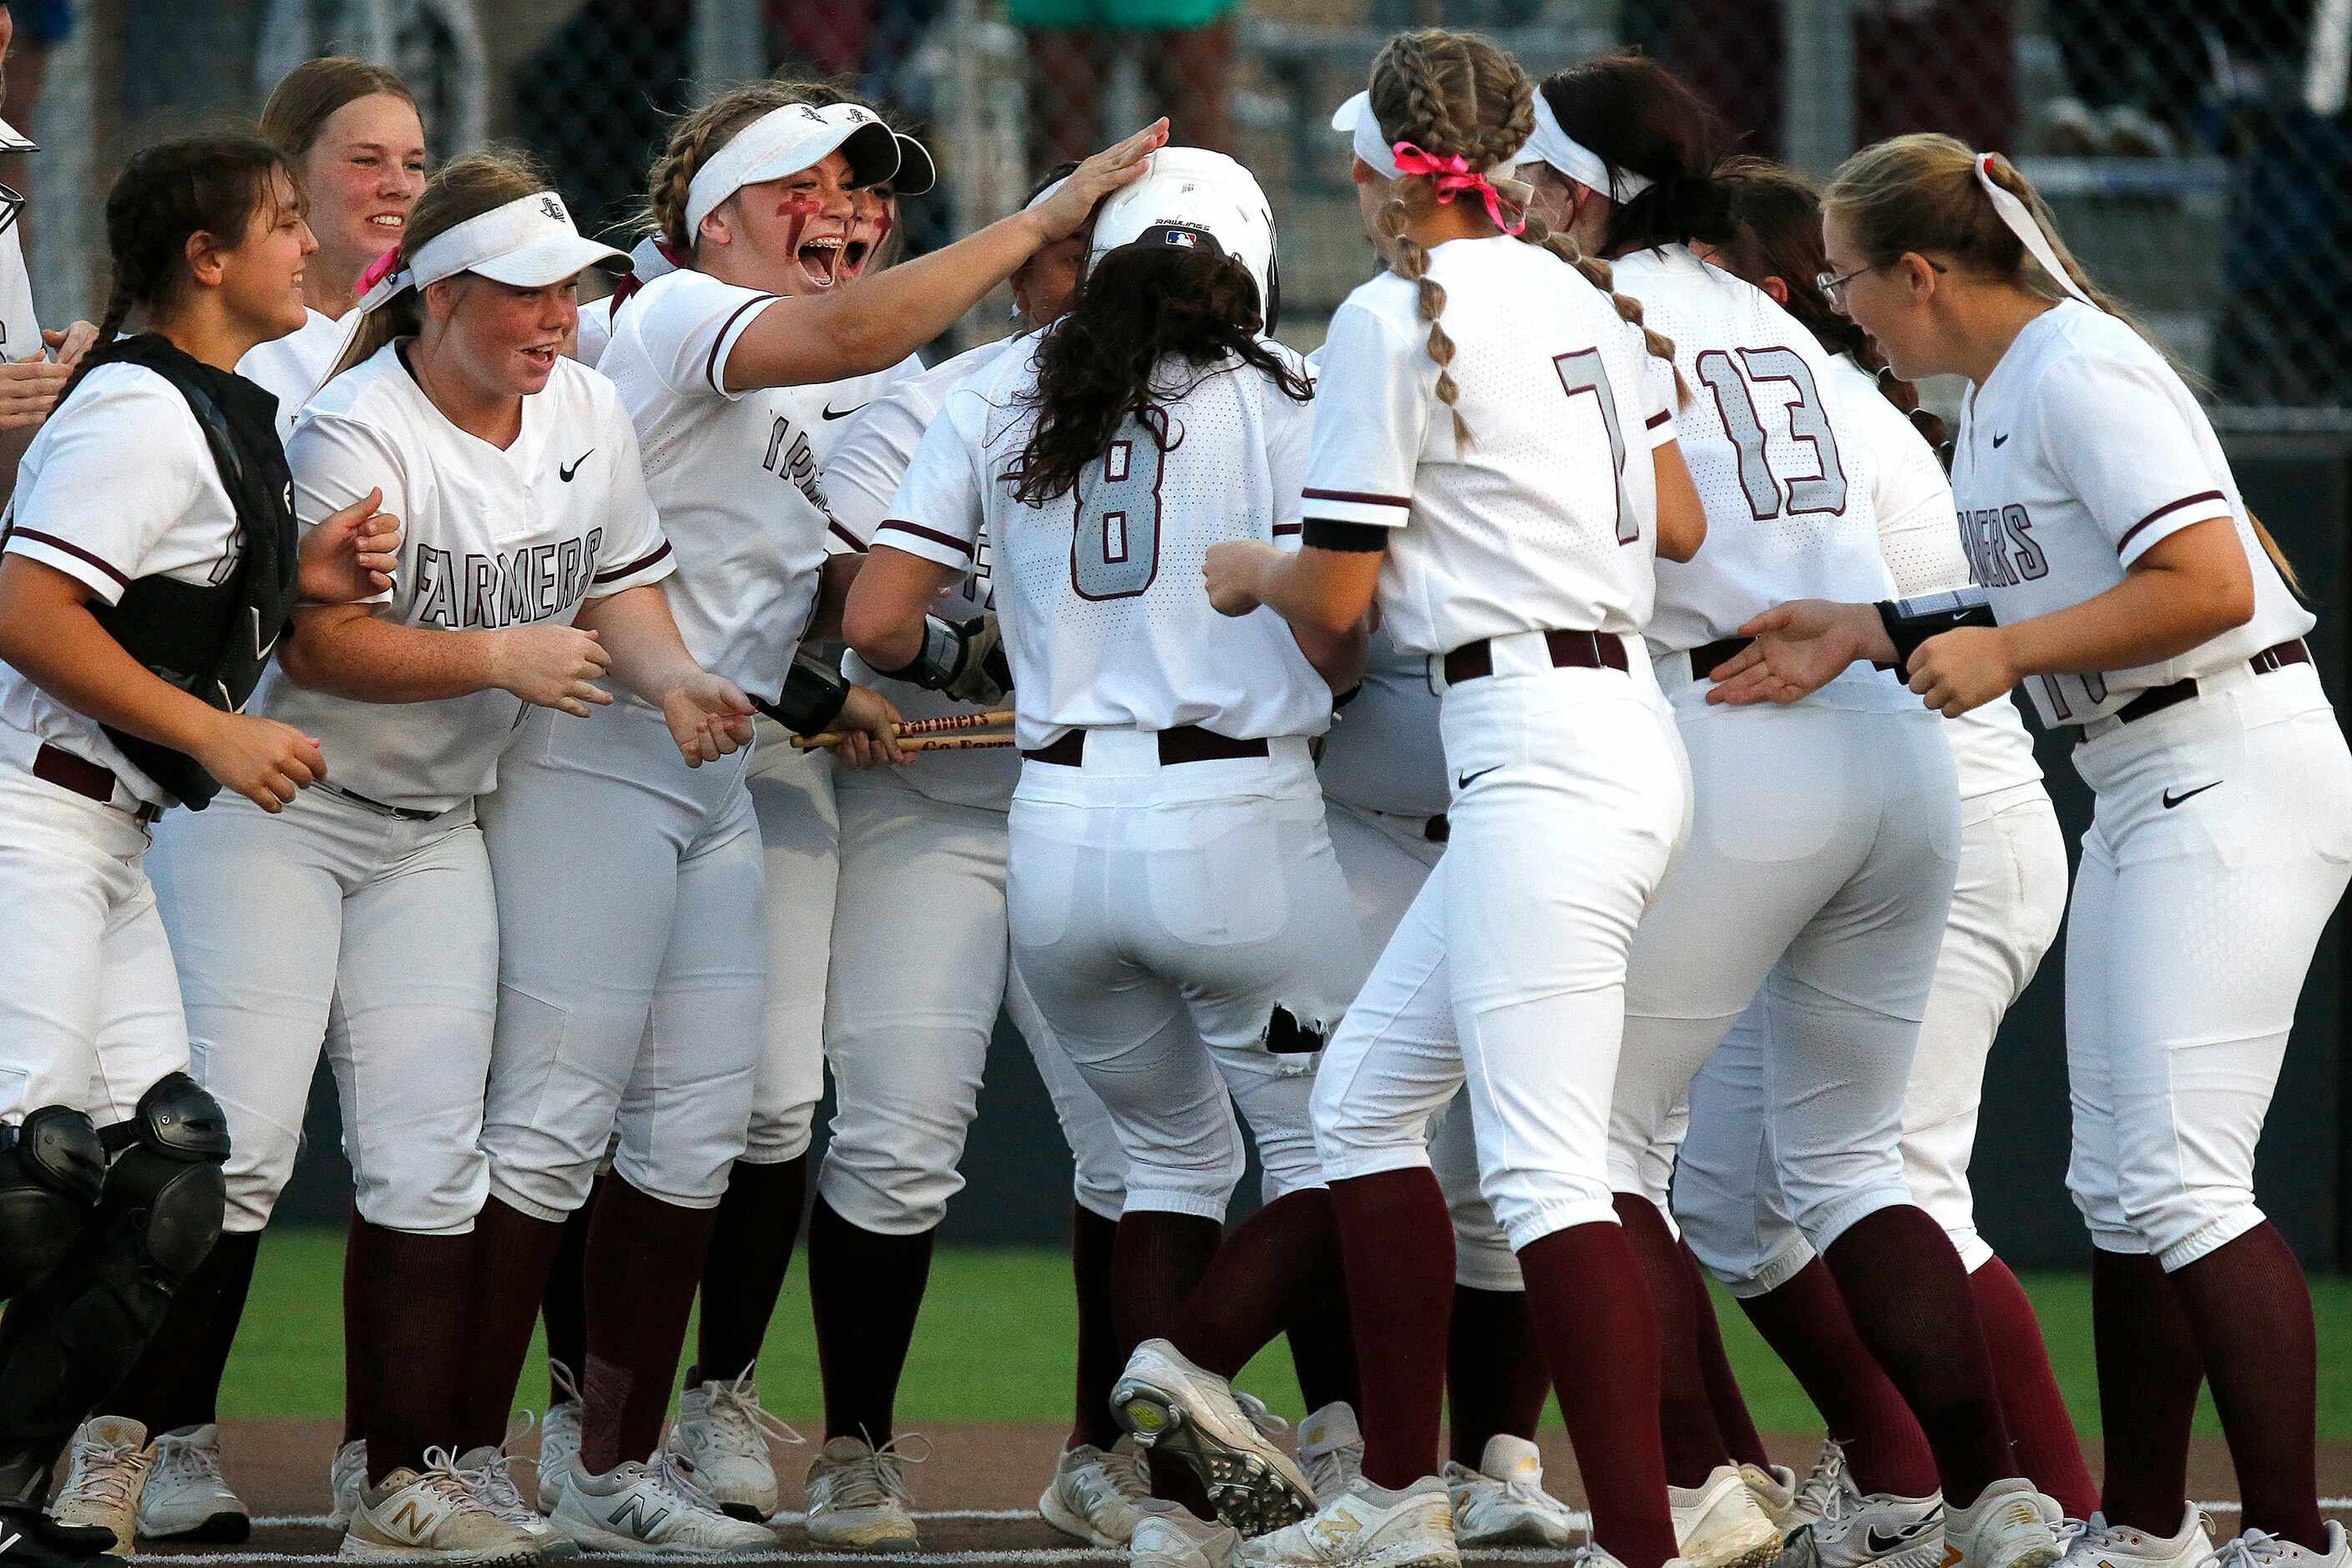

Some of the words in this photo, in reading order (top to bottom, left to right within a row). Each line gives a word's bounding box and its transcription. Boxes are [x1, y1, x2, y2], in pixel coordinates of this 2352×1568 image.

[1155, 219, 1211, 231] RAWLINGS
[1070, 402, 1170, 602] 8
[1552, 346, 1640, 547] 7
[1696, 346, 1849, 522] 13
[416, 527, 603, 629] FARMERS
